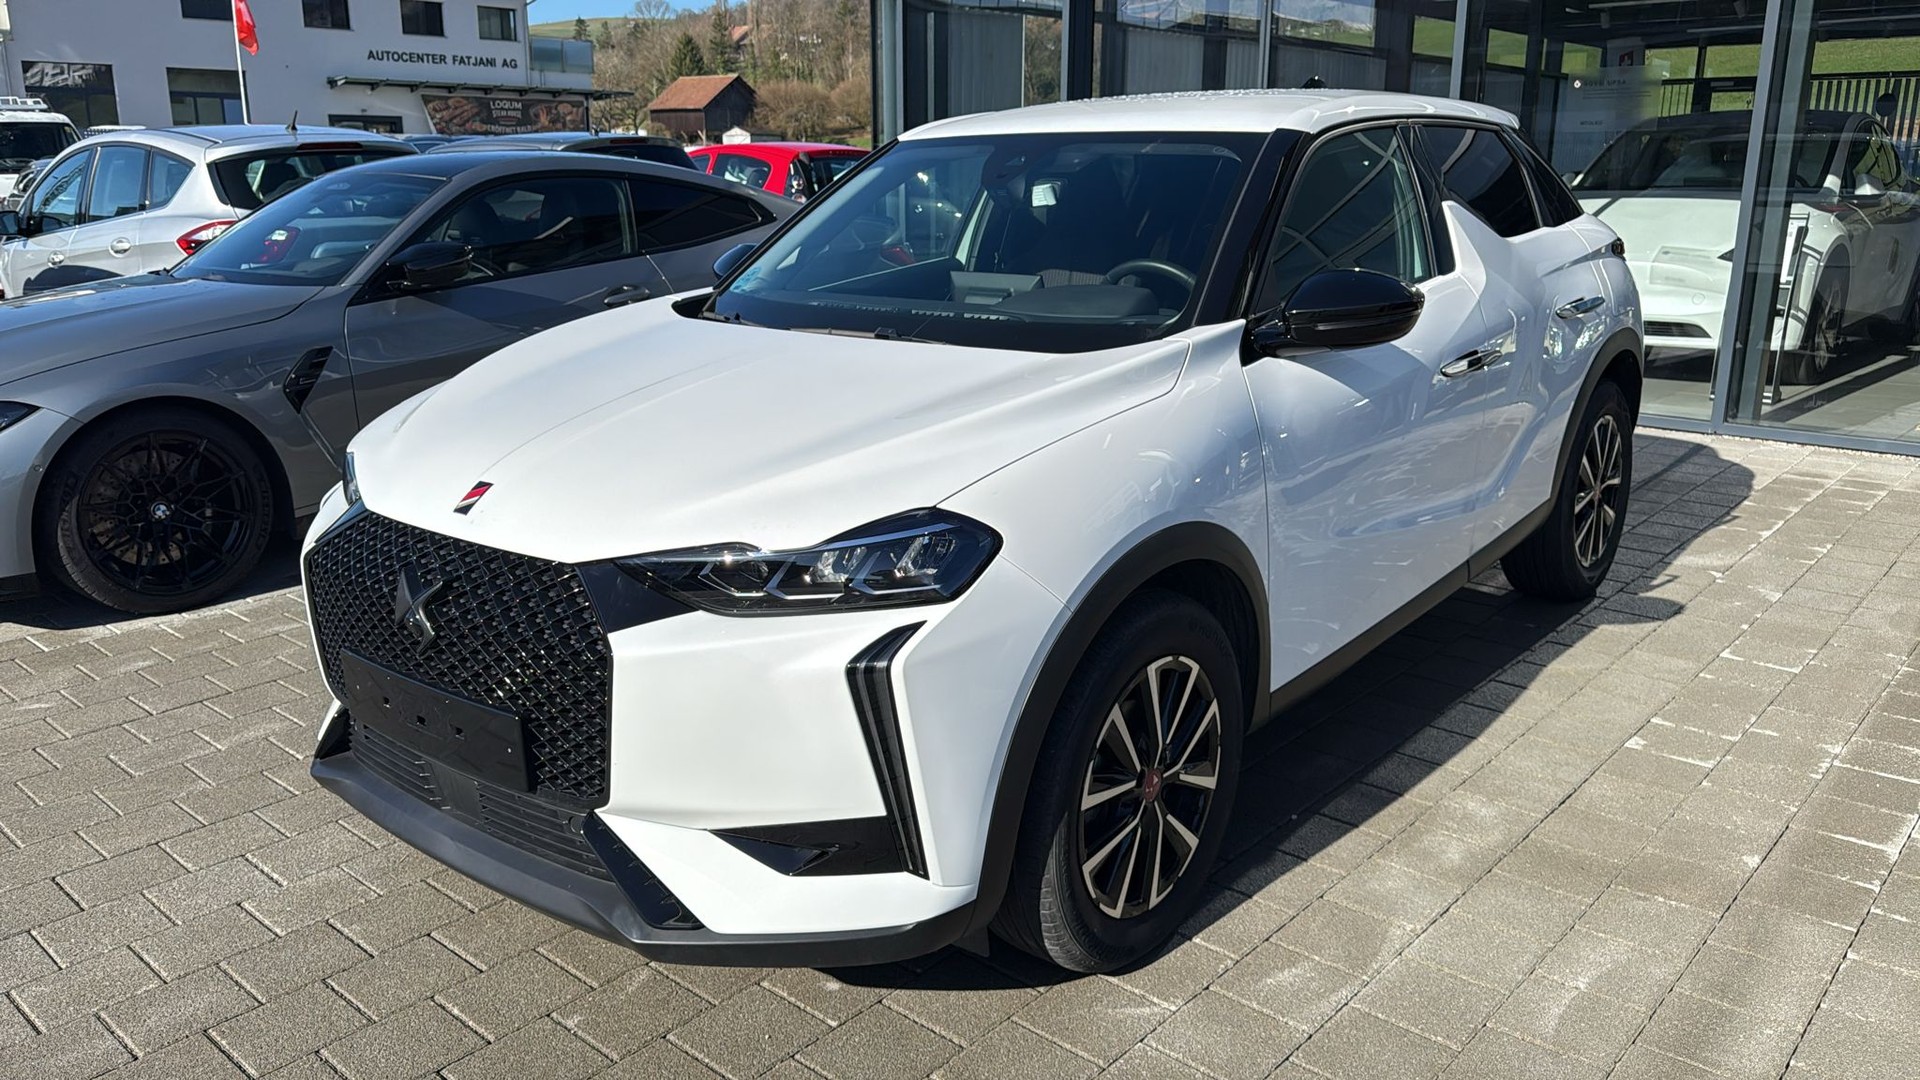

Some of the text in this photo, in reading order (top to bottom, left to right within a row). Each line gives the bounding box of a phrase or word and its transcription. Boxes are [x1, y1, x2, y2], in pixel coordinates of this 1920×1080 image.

[367, 50, 518, 69] AUTOCENTER FATJANI AG
[490, 100, 523, 110] LOQUM
